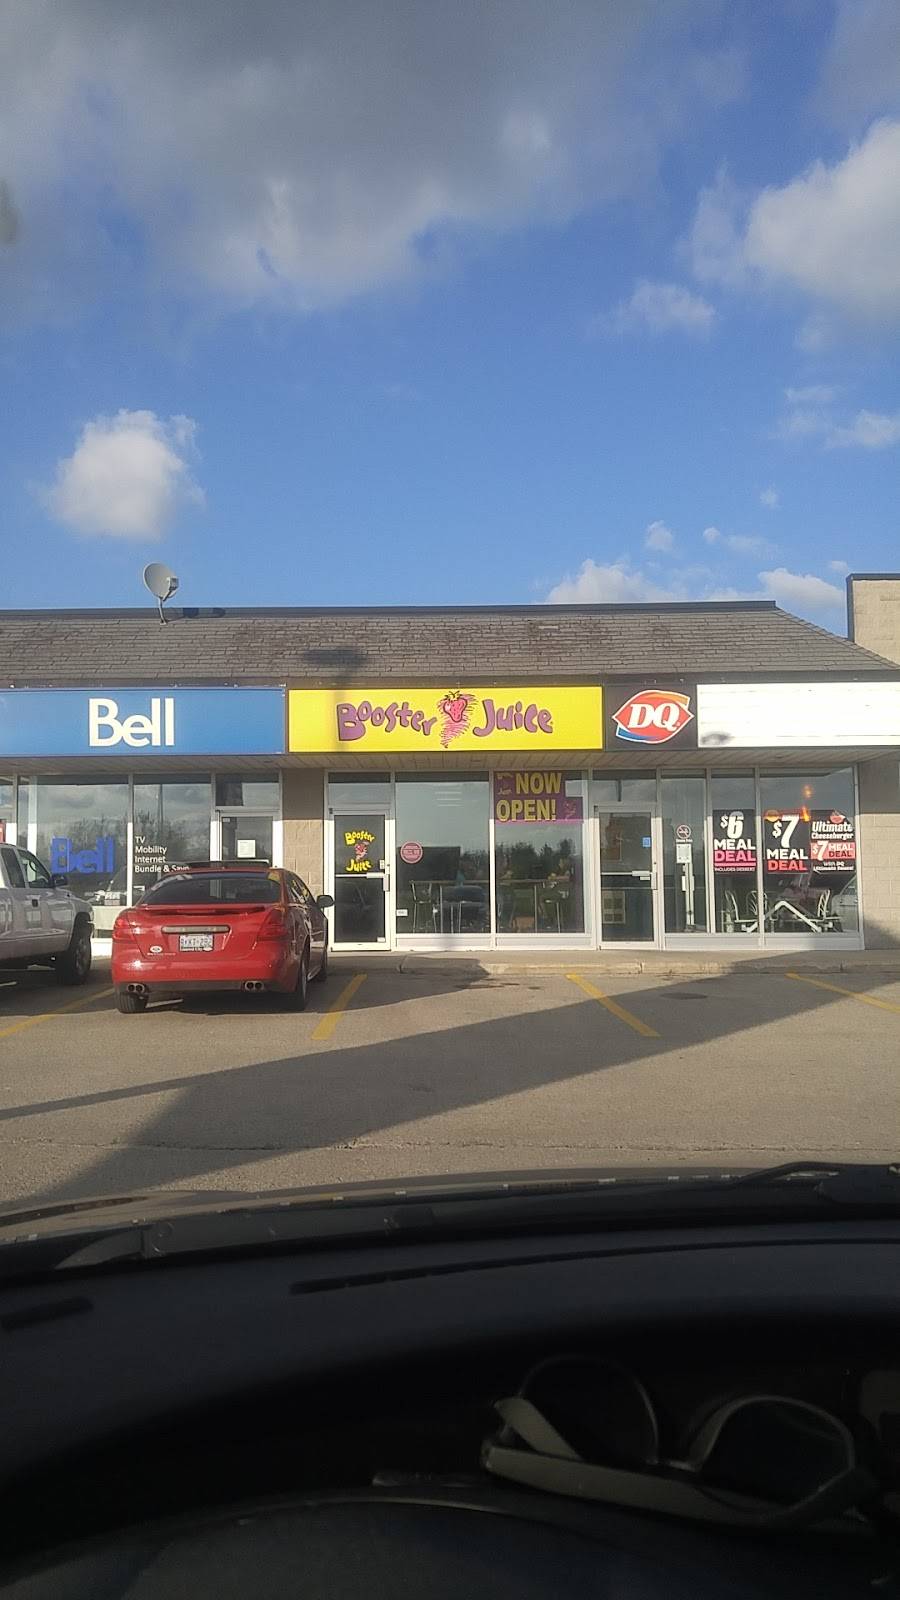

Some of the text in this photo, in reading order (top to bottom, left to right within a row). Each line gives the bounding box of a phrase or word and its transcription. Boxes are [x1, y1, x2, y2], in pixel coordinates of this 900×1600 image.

[88, 697, 175, 747] Bell
[336, 699, 554, 742] Booster Juice
[627, 703, 681, 732] DQ
[515, 772, 562, 794] NOW
[496, 799, 557, 822] OPEN!
[720, 811, 745, 839] $6
[772, 814, 800, 848] $7
[812, 821, 853, 833] Ultimate
[134, 835, 146, 844] TV
[344, 830, 376, 845] Booster
[713, 838, 756, 850] MEAL
[52, 836, 114, 875] Bell
[135, 845, 168, 855] Mobility
[714, 850, 757, 862] DEAL
[766, 848, 809, 860] MEAL
[812, 840, 829, 861] $7
[134, 855, 167, 864] Internet
[346, 859, 372, 872] Juice
[767, 860, 808, 871] DEAL
[134, 865, 161, 873] Bundle
[163, 865, 170, 873] &
